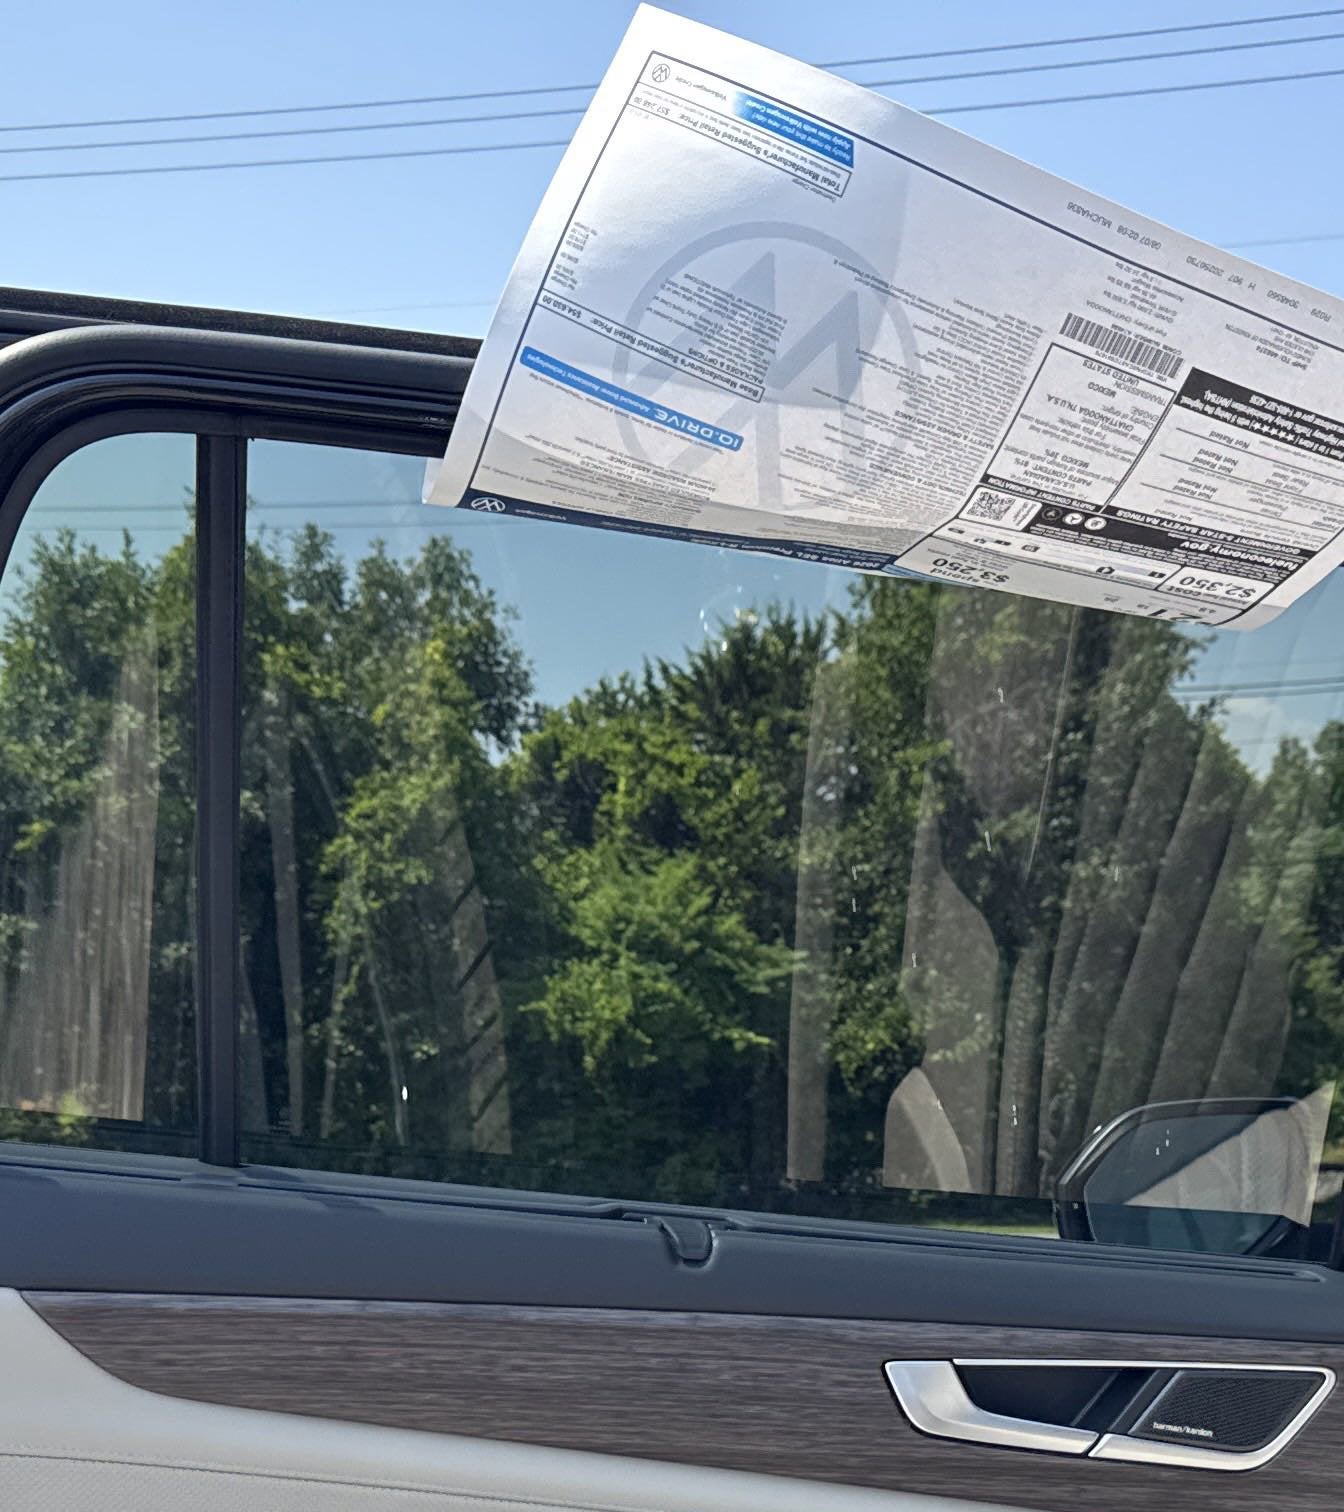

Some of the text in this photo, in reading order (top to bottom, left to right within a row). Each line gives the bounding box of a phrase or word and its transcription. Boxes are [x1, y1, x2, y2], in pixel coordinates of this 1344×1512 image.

[764, 106, 803, 129] Volkswagen
[698, 121, 721, 137] Retail
[720, 130, 763, 155] Suggested
[760, 148, 820, 181] Manufacturer's
[819, 175, 842, 192] Total
[589, 317, 613, 333] Price:
[612, 327, 637, 344] Retail
[636, 337, 680, 363] Suggested
[678, 357, 738, 388] Manufacturer's
[1081, 359, 1111, 376] STATES
[737, 382, 759, 397] Base
[1086, 381, 1116, 398] MEXICO
[1077, 405, 1134, 432] CHATTANOOGA
[1208, 430, 1233, 443] Rated
[1233, 438, 1249, 448] Not
[1192, 455, 1216, 468] Rated
[1197, 447, 1221, 461] Rated
[1222, 455, 1238, 466] Not
[1217, 463, 1233, 473] Not
[1067, 473, 1092, 487] PARTS
[1177, 476, 1201, 488] Rated
[1201, 483, 1218, 493] Not
[1171, 483, 1197, 496] Rated
[1196, 491, 1212, 500] Not
[1116, 508, 1160, 525] RATINGS
[1233, 535, 1300, 555] GOVERNMENT
[1179, 538, 1299, 571] fueleconomy.gov
[931, 555, 1009, 584] $3,250
[1165, 584, 1202, 596] cost
[1178, 574, 1256, 599] $2,350
